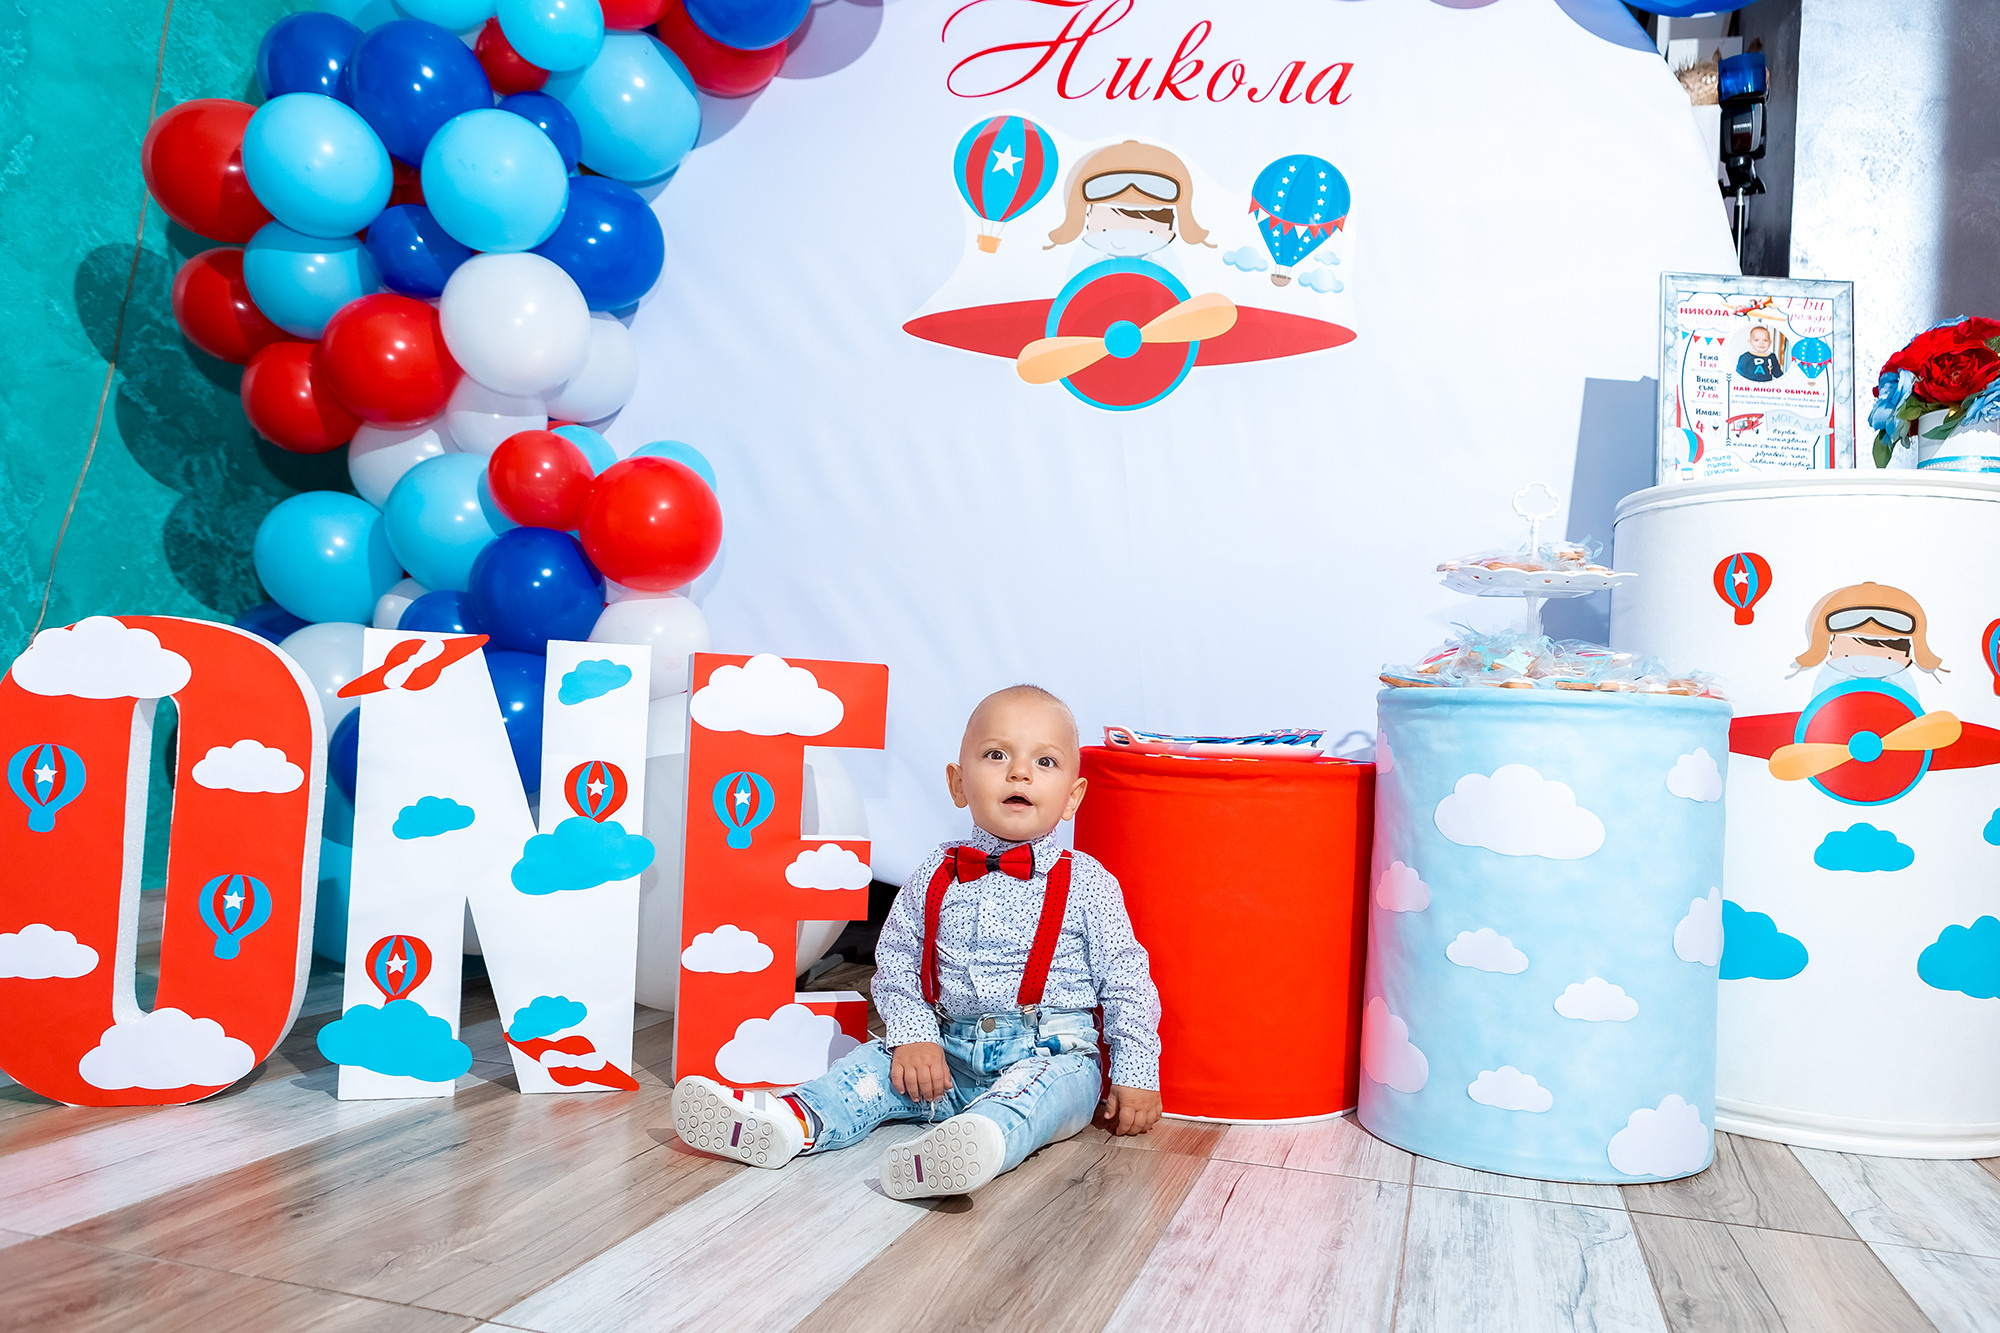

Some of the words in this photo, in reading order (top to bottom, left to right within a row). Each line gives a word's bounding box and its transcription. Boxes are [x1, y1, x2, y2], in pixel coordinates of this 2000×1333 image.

[942, 0, 1355, 106] Никола
[1680, 307, 1730, 317] НИКОЛА
[1696, 375, 1720, 385] Висок
[1695, 408, 1722, 417] Имам:
[1695, 420, 1706, 433] 4
[0, 614, 890, 1107] ONE
